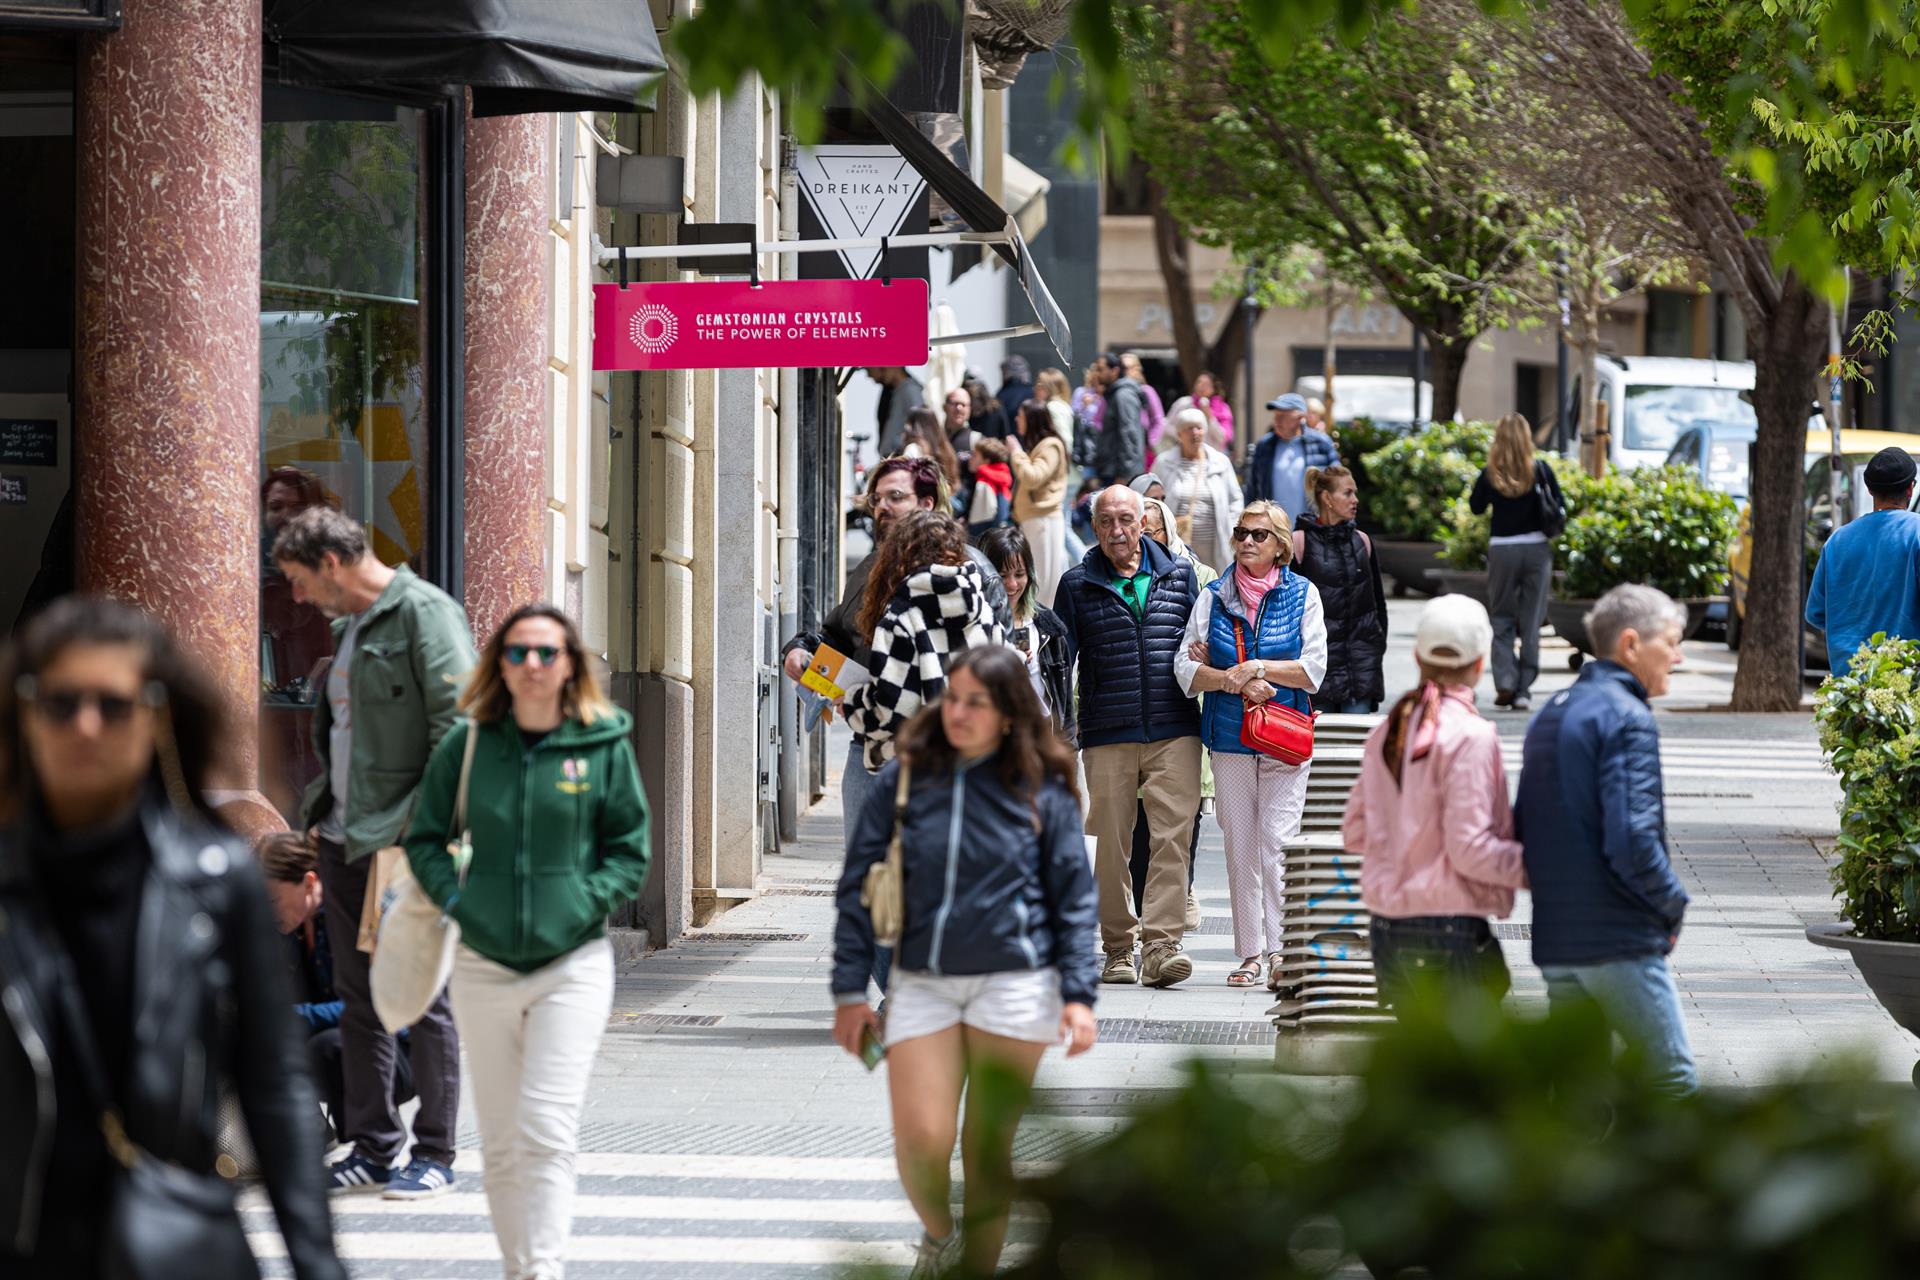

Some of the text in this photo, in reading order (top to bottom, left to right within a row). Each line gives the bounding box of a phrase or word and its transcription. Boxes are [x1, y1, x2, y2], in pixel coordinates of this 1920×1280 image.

[814, 183, 909, 194] DREIKANT
[696, 312, 862, 326] GEMSTONIAN CRYSTALS
[1136, 303, 1215, 331] PP
[697, 327, 886, 340] THE POWER OF ELEMENTS
